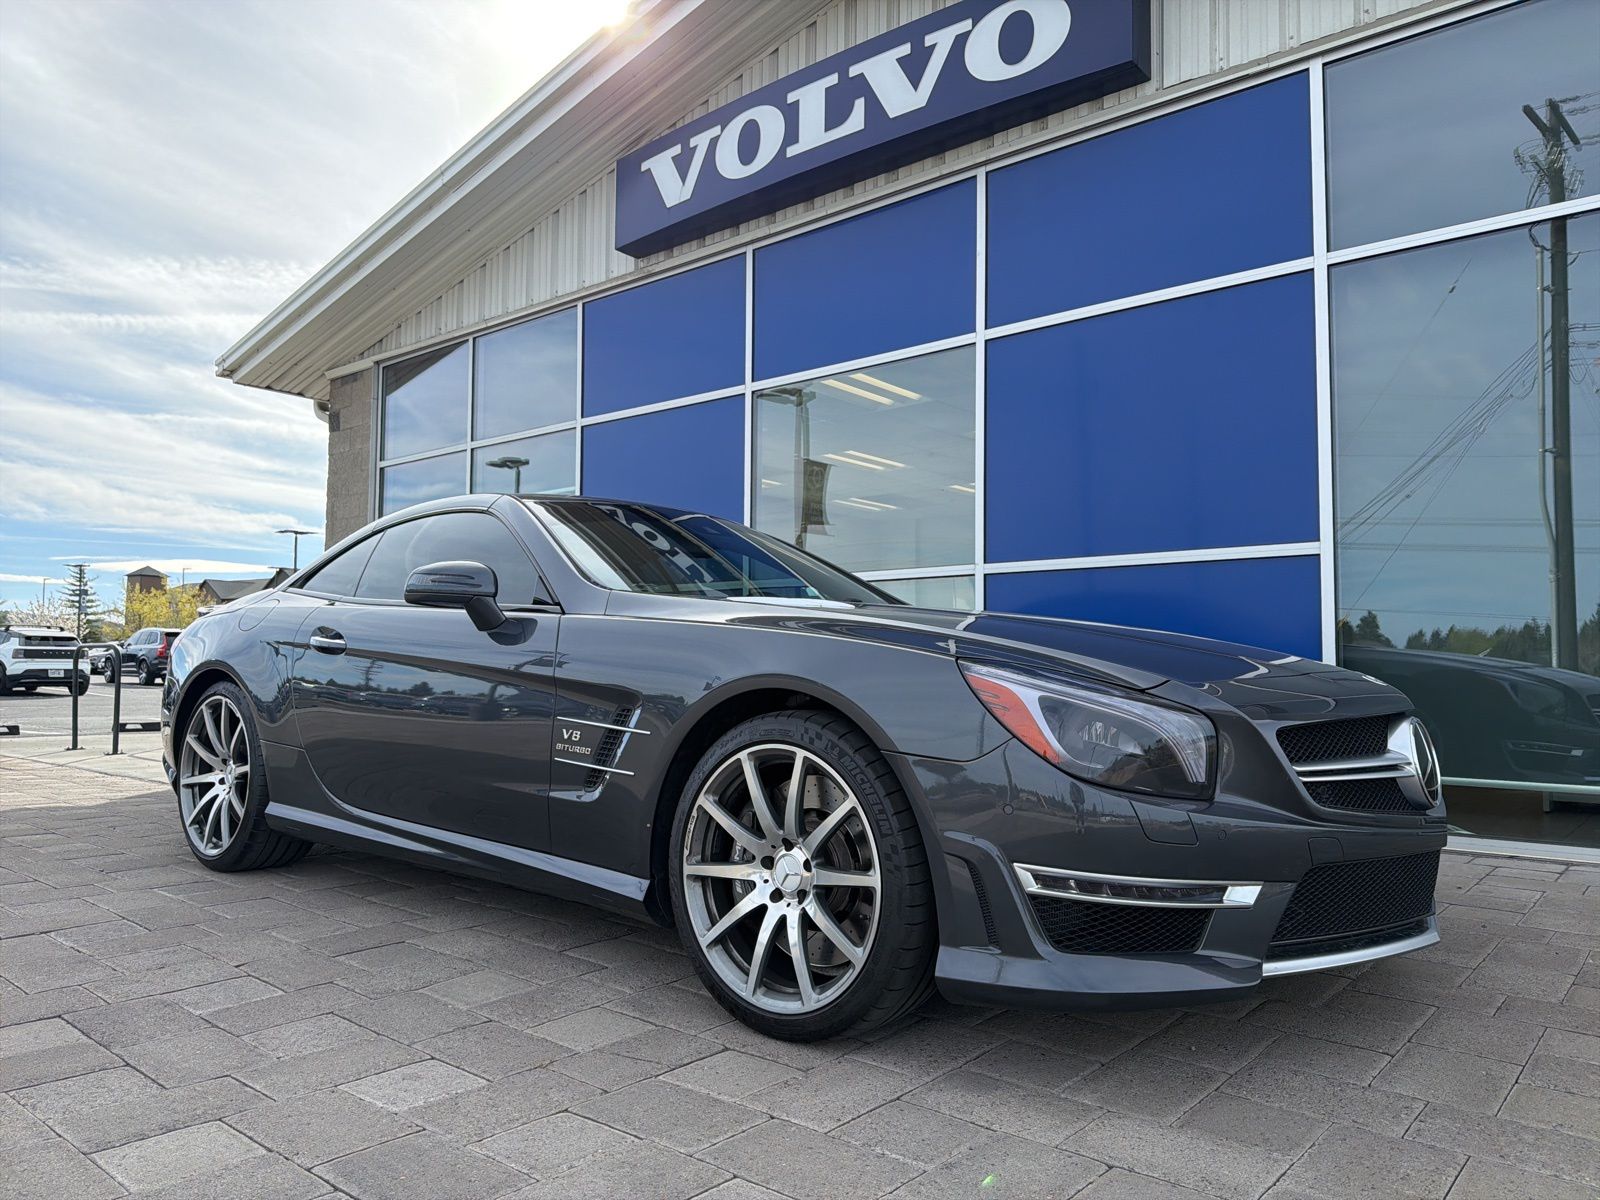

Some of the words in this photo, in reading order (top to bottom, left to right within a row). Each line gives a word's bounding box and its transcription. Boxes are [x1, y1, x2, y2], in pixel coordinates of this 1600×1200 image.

[641, 0, 1072, 208] VOLVO
[556, 743, 591, 755] BITURBO
[562, 728, 581, 741] V8
[840, 755, 893, 835] MICHELIN
